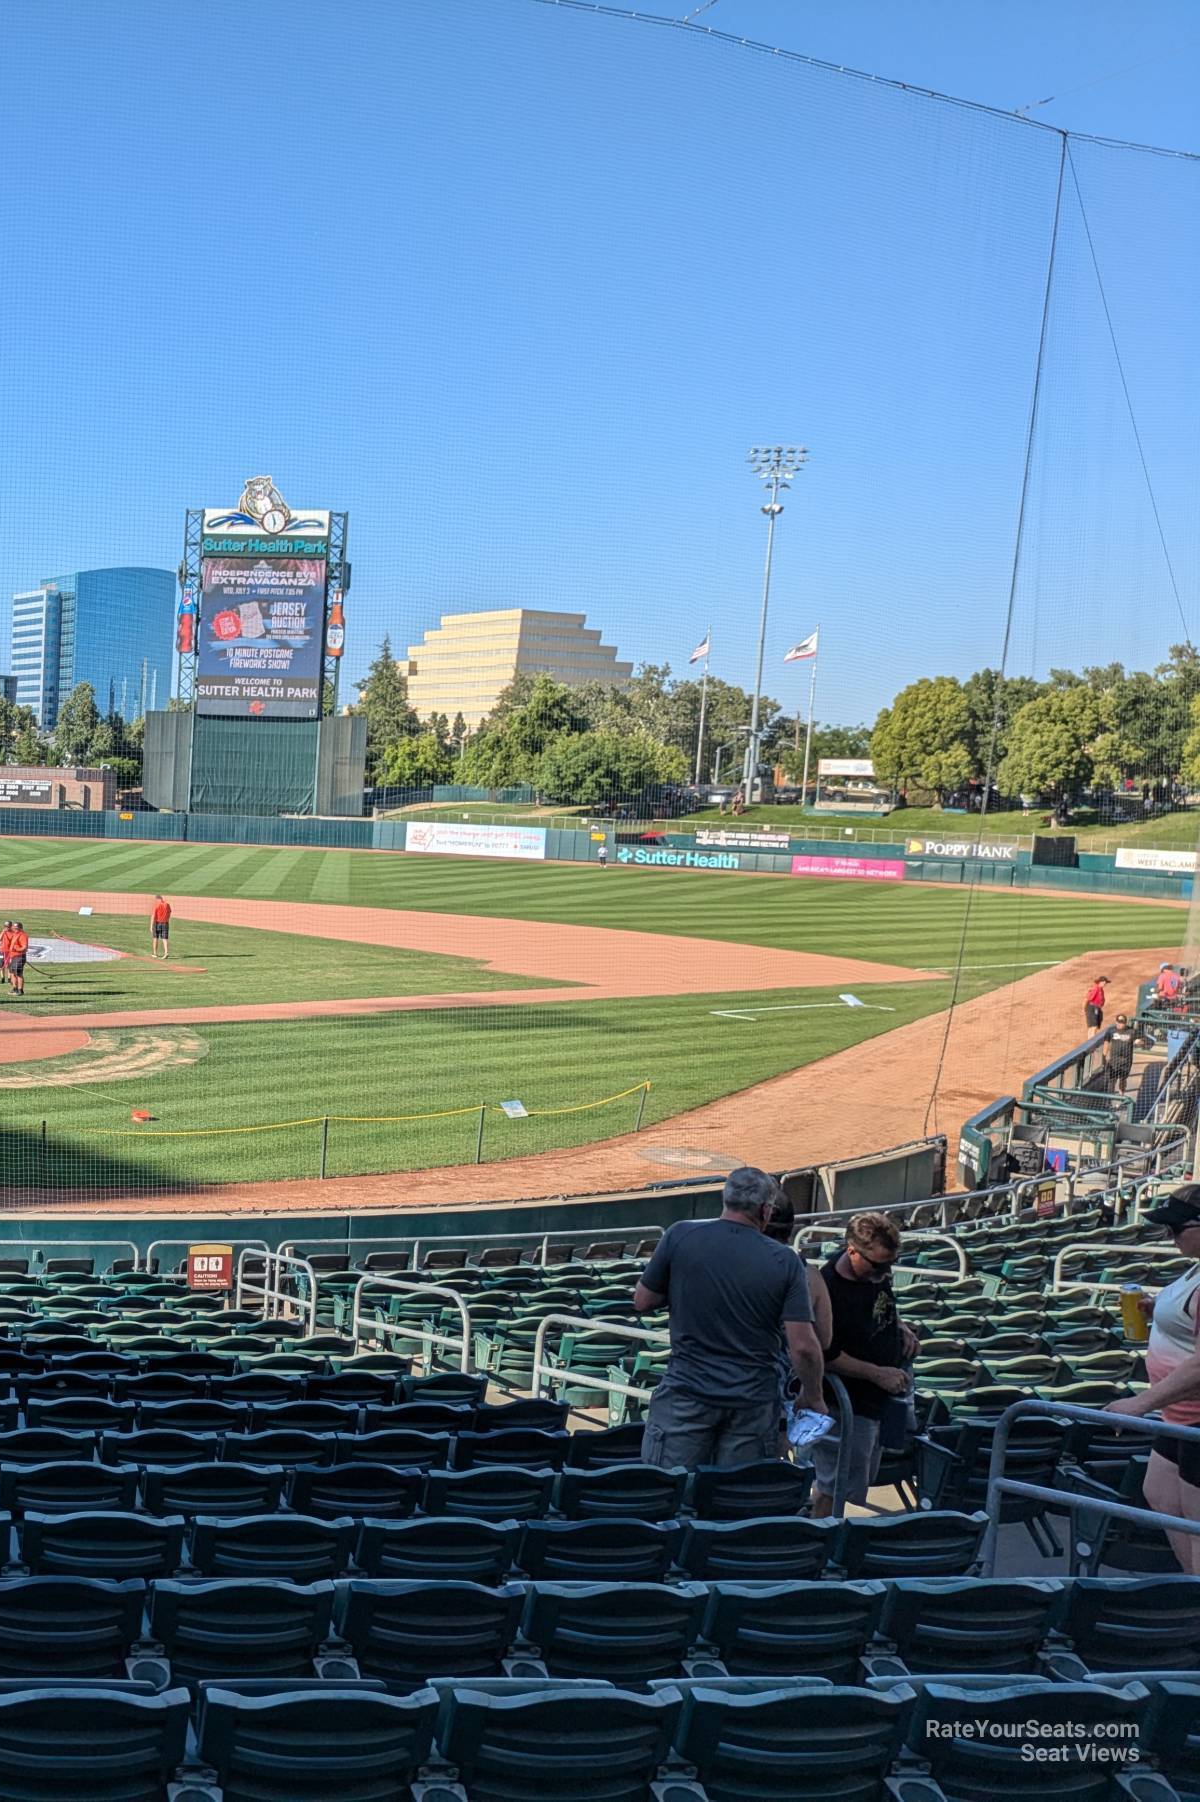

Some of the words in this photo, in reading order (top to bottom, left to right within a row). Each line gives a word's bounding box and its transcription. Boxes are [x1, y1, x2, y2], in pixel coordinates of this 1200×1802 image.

[203, 538, 246, 552] Sutter
[248, 539, 293, 553] Health
[294, 541, 326, 553] Park
[211, 569, 293, 578] INDEPENDENCE
[211, 577, 315, 586] EXTRAVAGANZA
[272, 602, 307, 616] JERSEY
[272, 617, 305, 628] AUCTION
[235, 648, 258, 658] MINUTE
[260, 649, 293, 660] POSTGAME
[230, 659, 266, 668] FIREWORKS
[267, 660, 290, 669] SHOW!
[198, 685, 239, 696] SUTTER
[242, 686, 284, 697] HEALTH
[287, 687, 317, 698] PARK
[925, 843, 969, 857] POPPY
[634, 848, 684, 866] Sutter
[685, 851, 739, 869] Health
